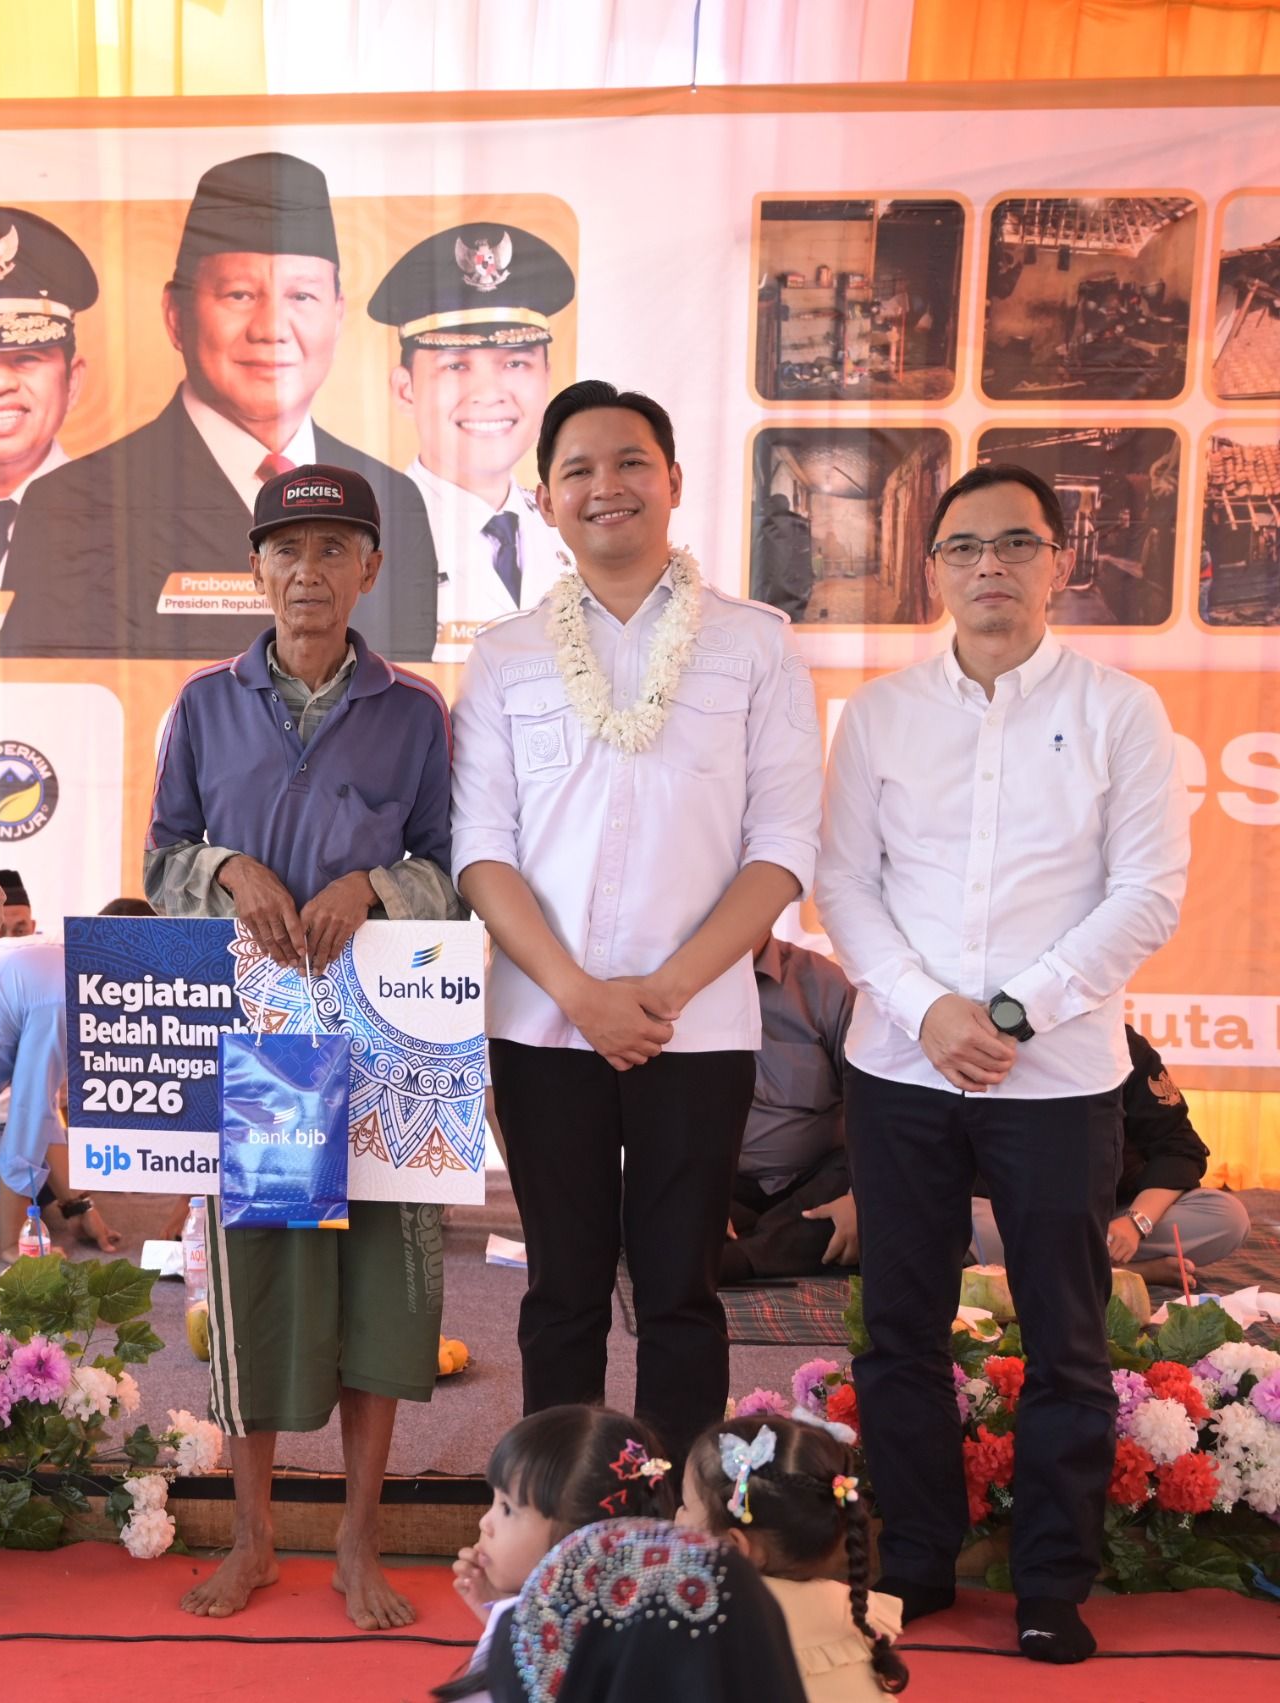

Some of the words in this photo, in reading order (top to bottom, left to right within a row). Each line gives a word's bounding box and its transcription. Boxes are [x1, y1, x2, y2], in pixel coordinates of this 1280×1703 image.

[165, 598, 219, 609] Presiden
[78, 974, 232, 1009] Kegiatan
[379, 976, 432, 999] bank
[440, 976, 481, 1005] bjb
[79, 1014, 157, 1044] Bedah
[80, 1051, 144, 1073] Tahun
[148, 1053, 219, 1079] Angga
[82, 1078, 183, 1114] 2026
[249, 1129, 291, 1146] bank
[295, 1128, 327, 1148] bjb
[85, 1144, 131, 1176] bjb
[137, 1149, 220, 1174] Tanda
